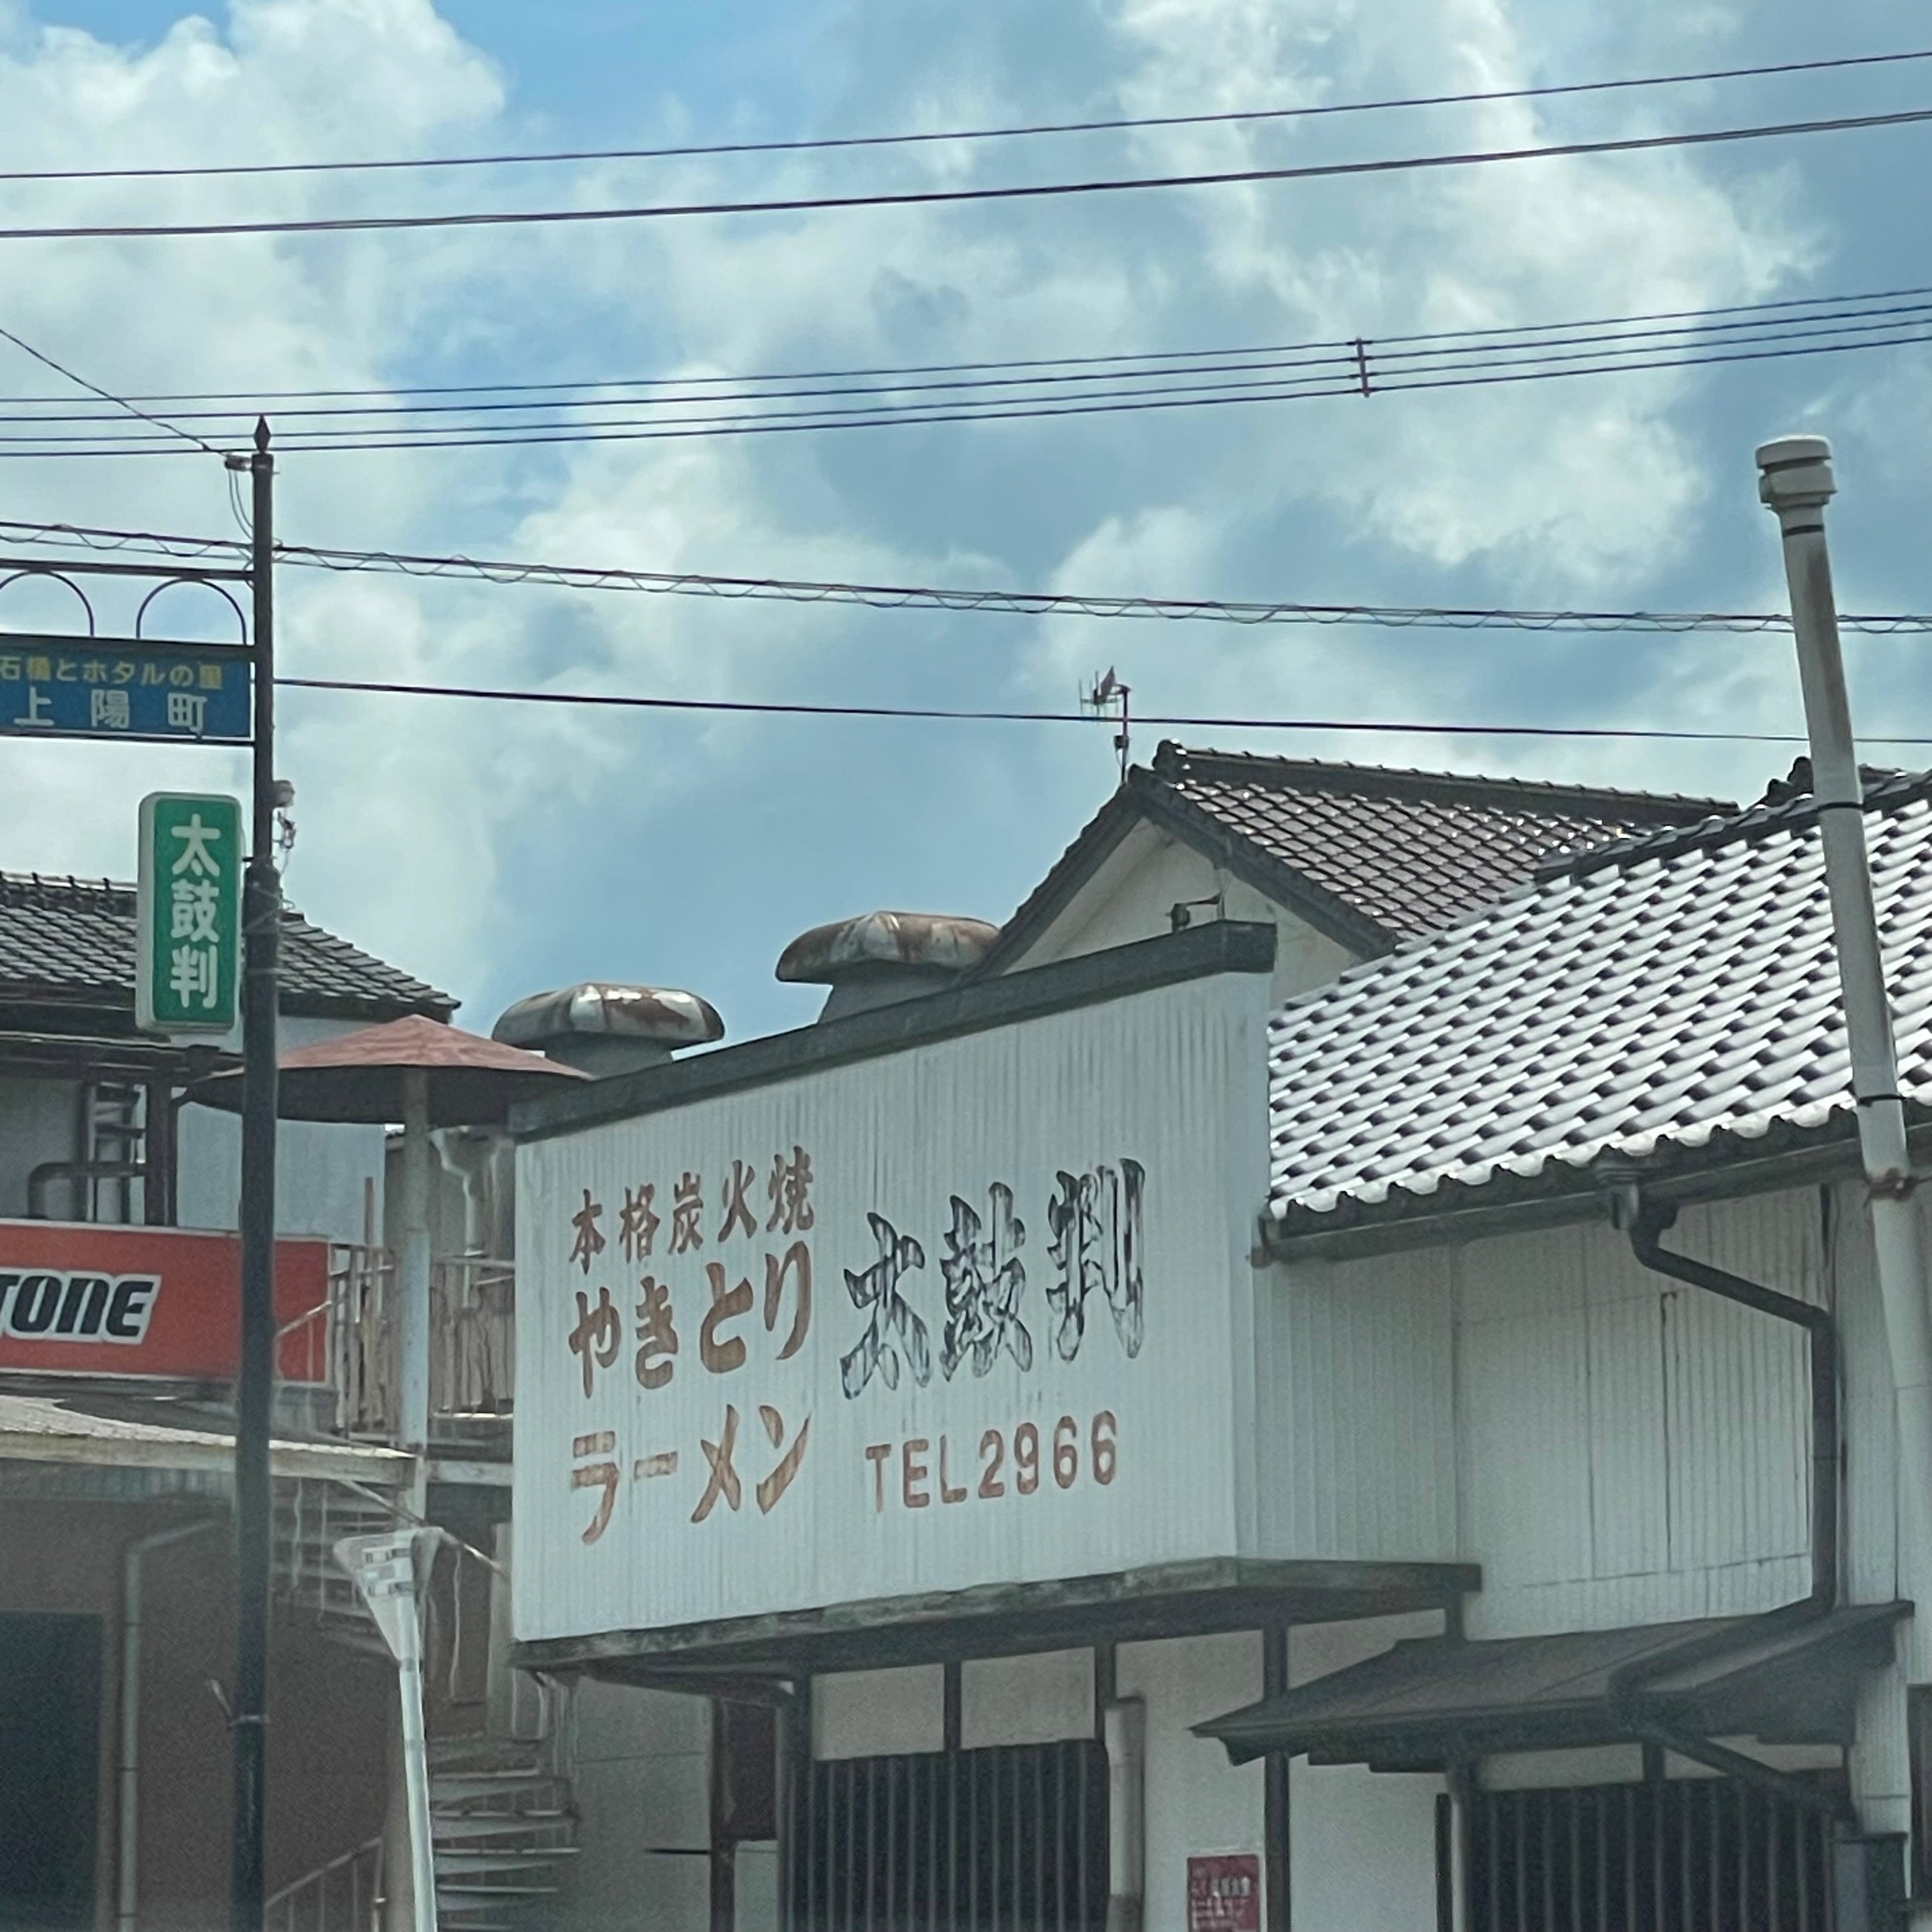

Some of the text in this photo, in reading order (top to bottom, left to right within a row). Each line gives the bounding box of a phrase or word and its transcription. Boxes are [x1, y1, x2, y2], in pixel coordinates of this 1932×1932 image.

[14, 686, 208, 736] 上陽町
[170, 813, 221, 1009] 太鼓判
[569, 1146, 813, 1275] 本格炭火焼
[839, 1158, 1146, 1400] 太鼓判
[568, 1240, 812, 1399] やきとり
[571, 1404, 811, 1545] ラーメン
